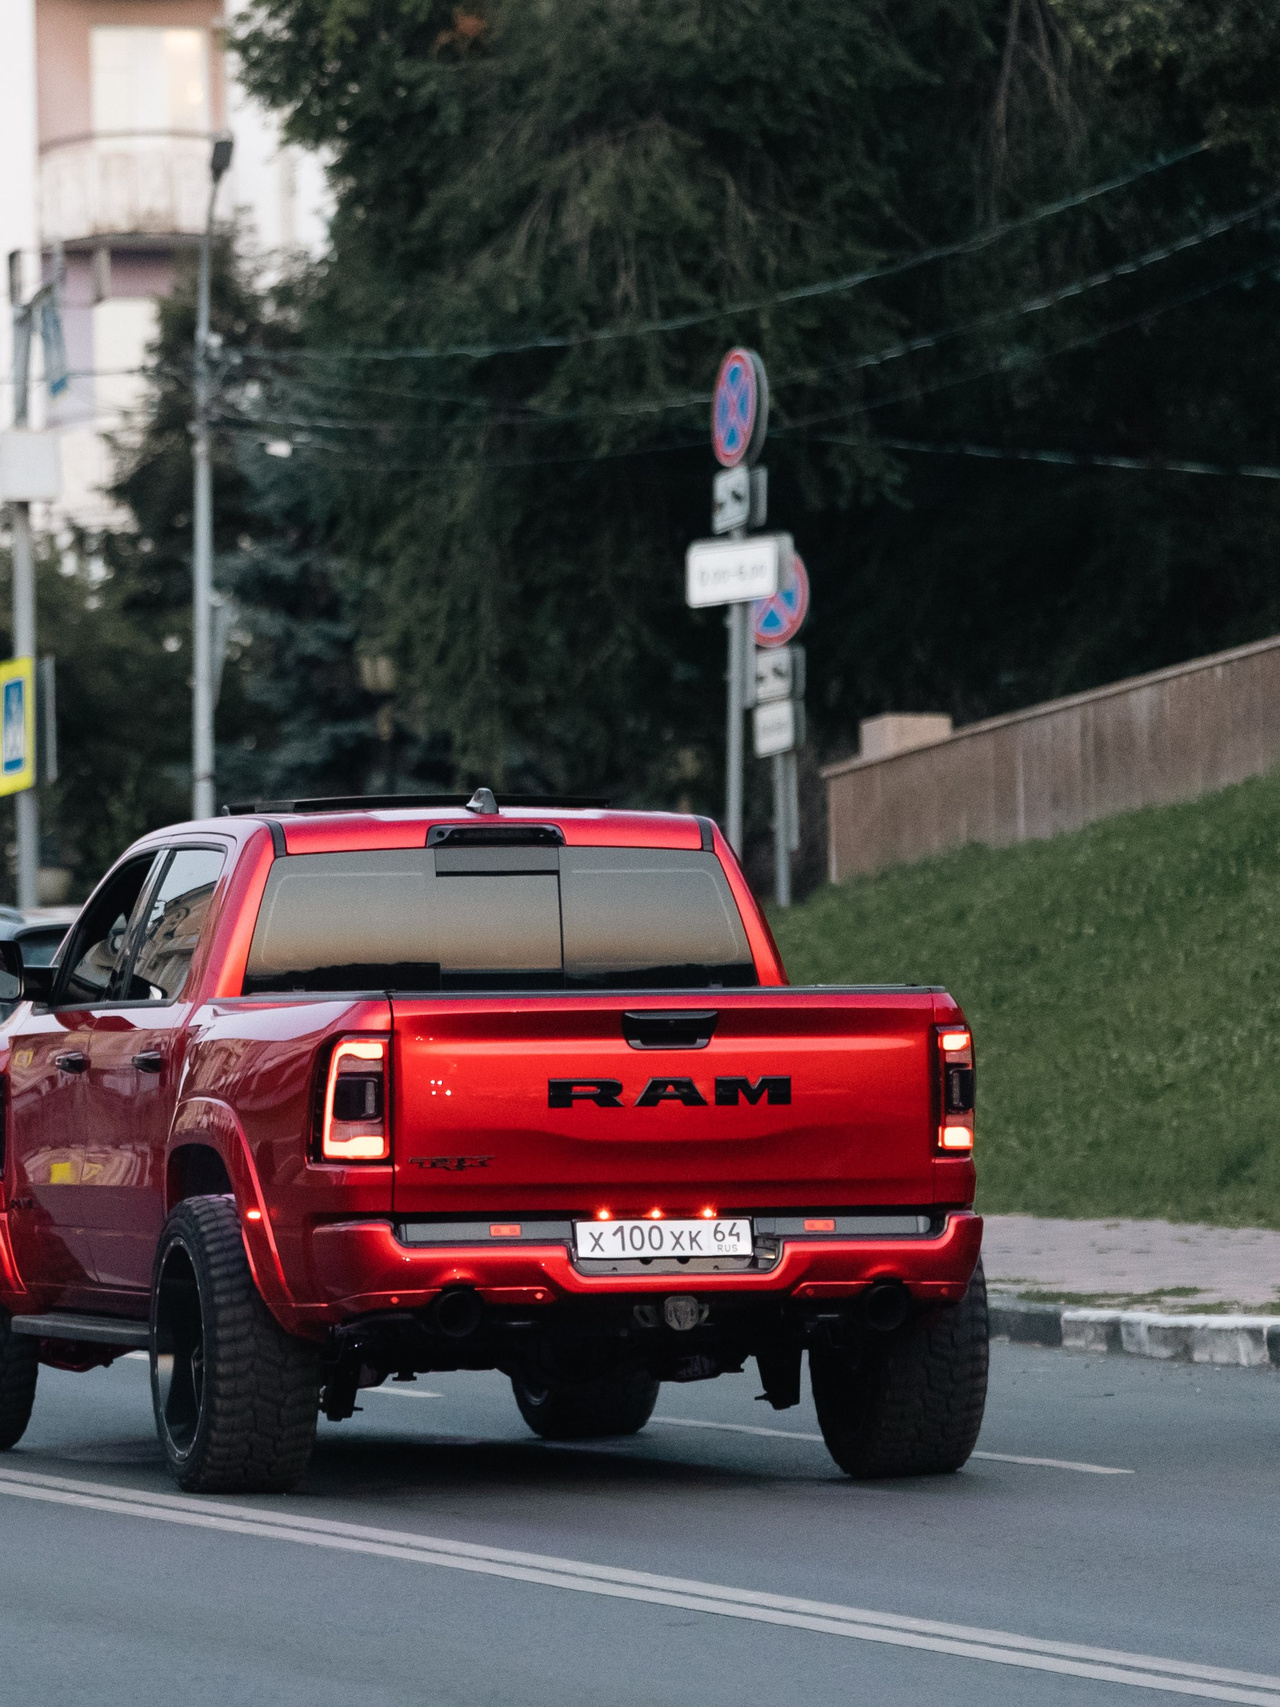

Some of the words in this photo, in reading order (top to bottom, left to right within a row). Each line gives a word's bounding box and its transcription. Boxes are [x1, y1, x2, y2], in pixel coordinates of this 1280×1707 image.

[548, 1076, 792, 1108] RAM
[713, 1222, 741, 1243] 64
[717, 1244, 739, 1253] RUS
